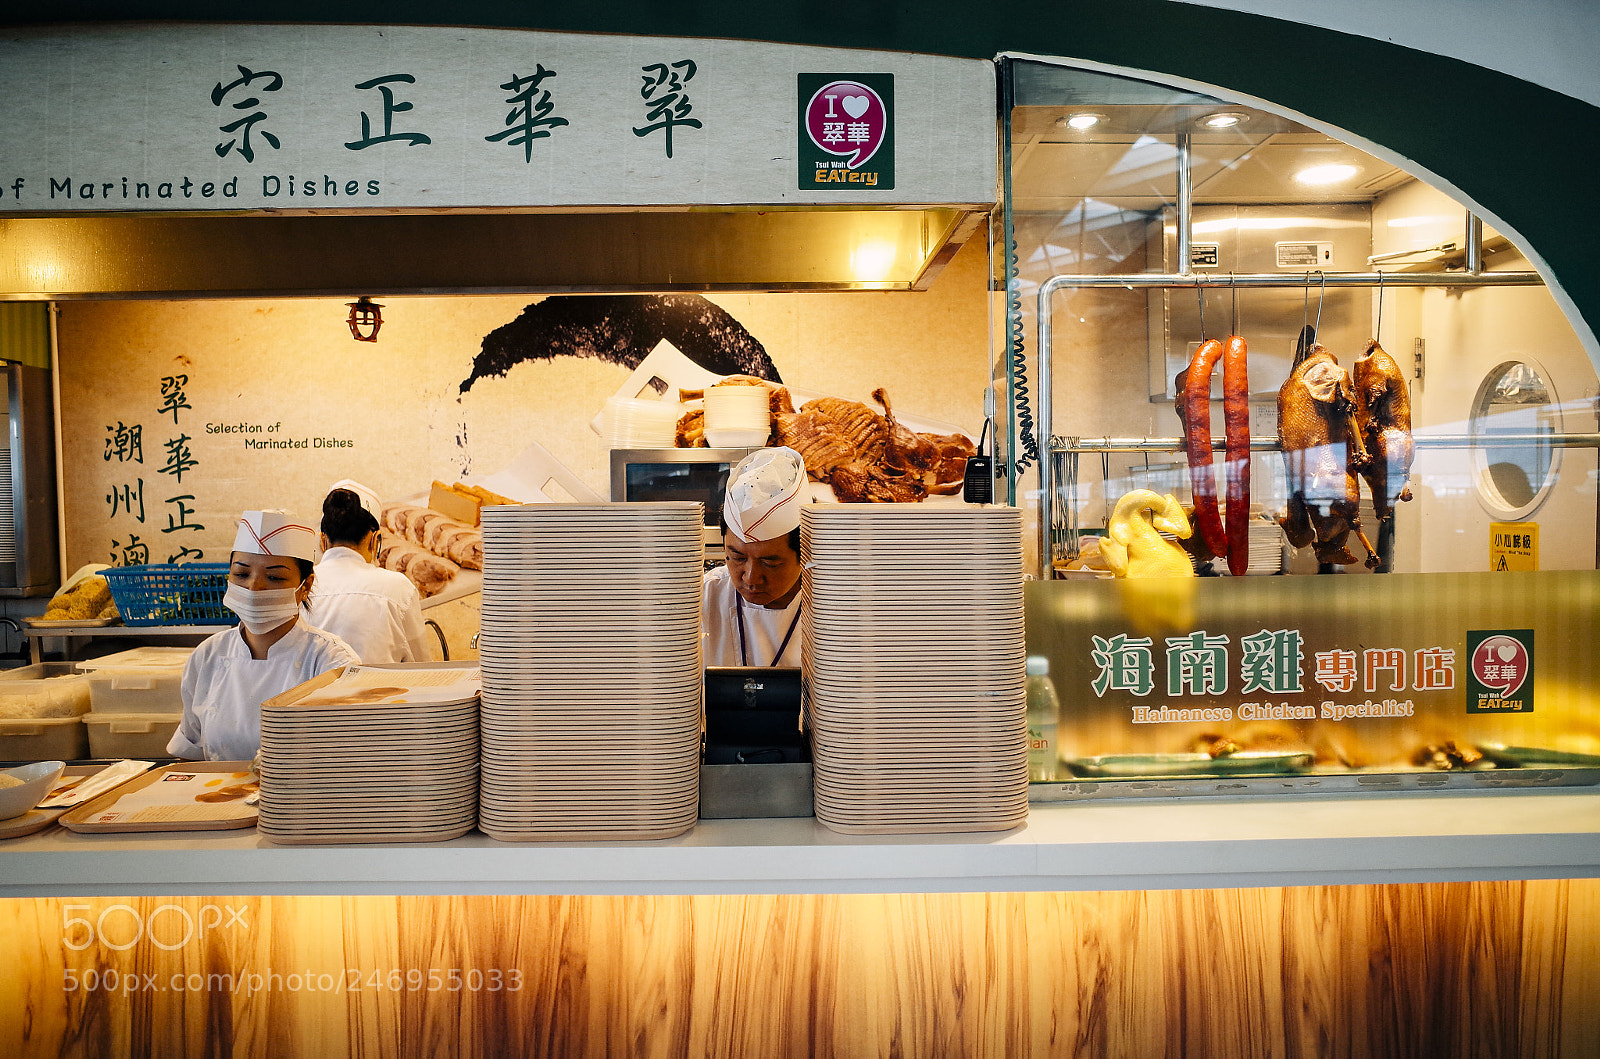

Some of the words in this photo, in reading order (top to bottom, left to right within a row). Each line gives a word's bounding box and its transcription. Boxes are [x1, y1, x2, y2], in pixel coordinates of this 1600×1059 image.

[824, 95, 838, 118] I
[822, 122, 871, 146] 翠華
[815, 161, 829, 169] Tsui
[831, 161, 846, 169] Wah
[815, 169, 879, 186] EATery
[50, 176, 239, 199] Marinated
[262, 174, 381, 197] Dishes
[205, 422, 262, 434] Selection
[267, 421, 281, 433] of
[245, 438, 308, 449] Marinated
[313, 437, 354, 448] Dishes
[1485, 645, 1495, 662] I
[1483, 664, 1517, 682] 翠華
[1132, 705, 1232, 724] Hainanese
[1237, 701, 1316, 721] Chicken
[1321, 699, 1414, 721] Specialist
[1477, 698, 1523, 710] EATery
